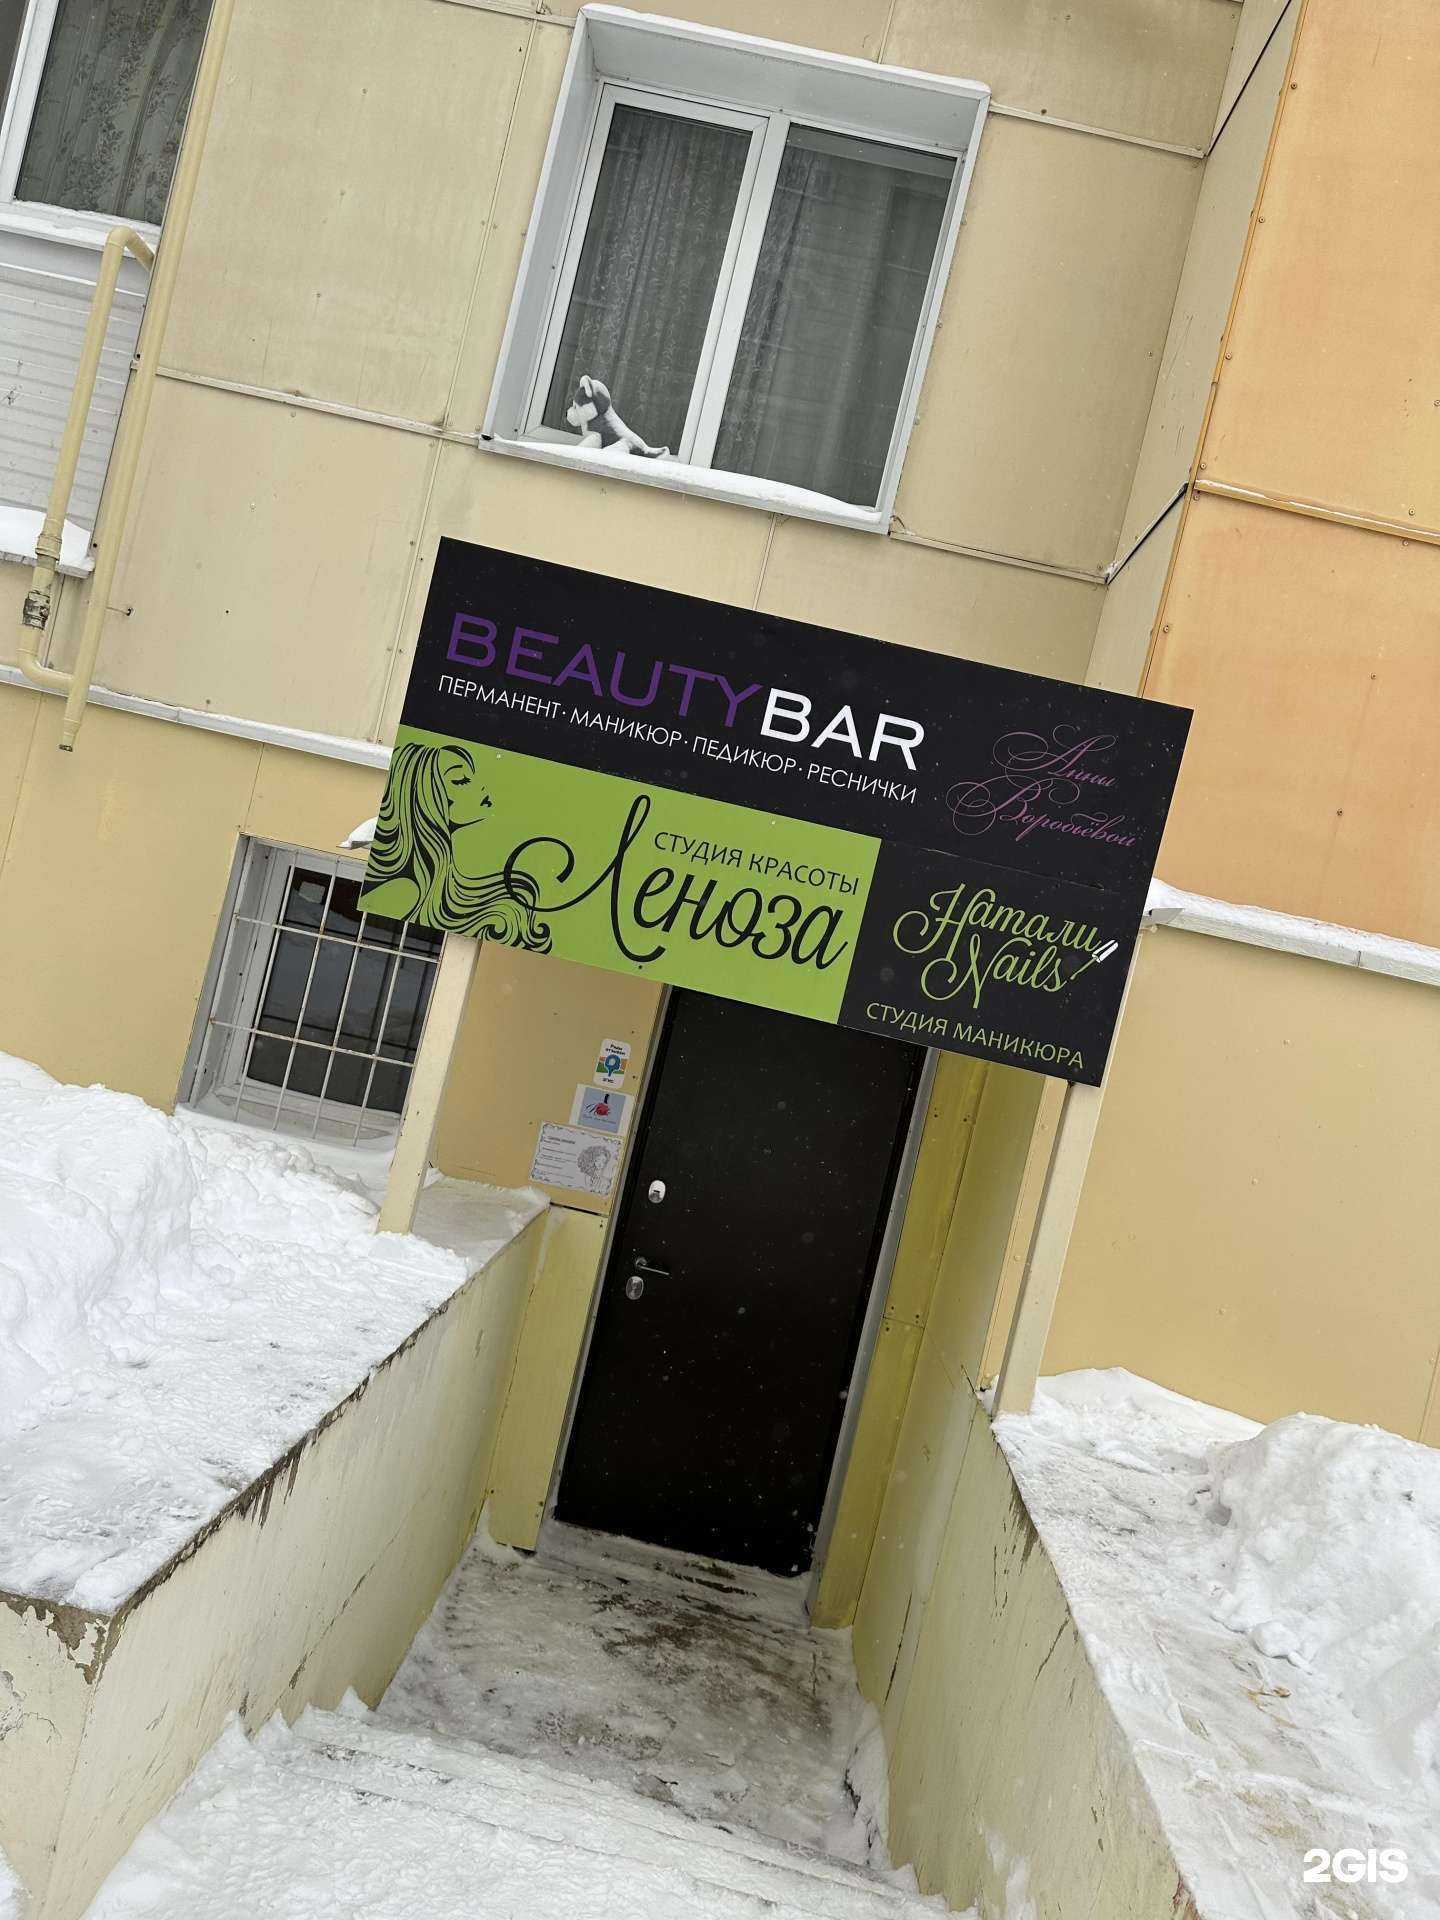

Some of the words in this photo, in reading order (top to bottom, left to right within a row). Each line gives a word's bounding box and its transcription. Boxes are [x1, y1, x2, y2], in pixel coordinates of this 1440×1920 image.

[438, 674, 561, 719] ПЕРМАНЕНТ
[570, 708, 682, 747] МАНИКЮР
[692, 736, 797, 774] ПЕДИКЮР
[807, 763, 917, 804] РЕСНИЧКИ
[503, 794, 848, 970] Леноза
[654, 831, 743, 867] СТУДИЯ
[749, 853, 859, 895] КРАСОТЫ
[893, 883, 1102, 960] Натали
[921, 933, 1067, 1009] Nails
[866, 1002, 949, 1036] СТУДИЯ
[953, 1022, 1083, 1069] МАНИКЮРА
